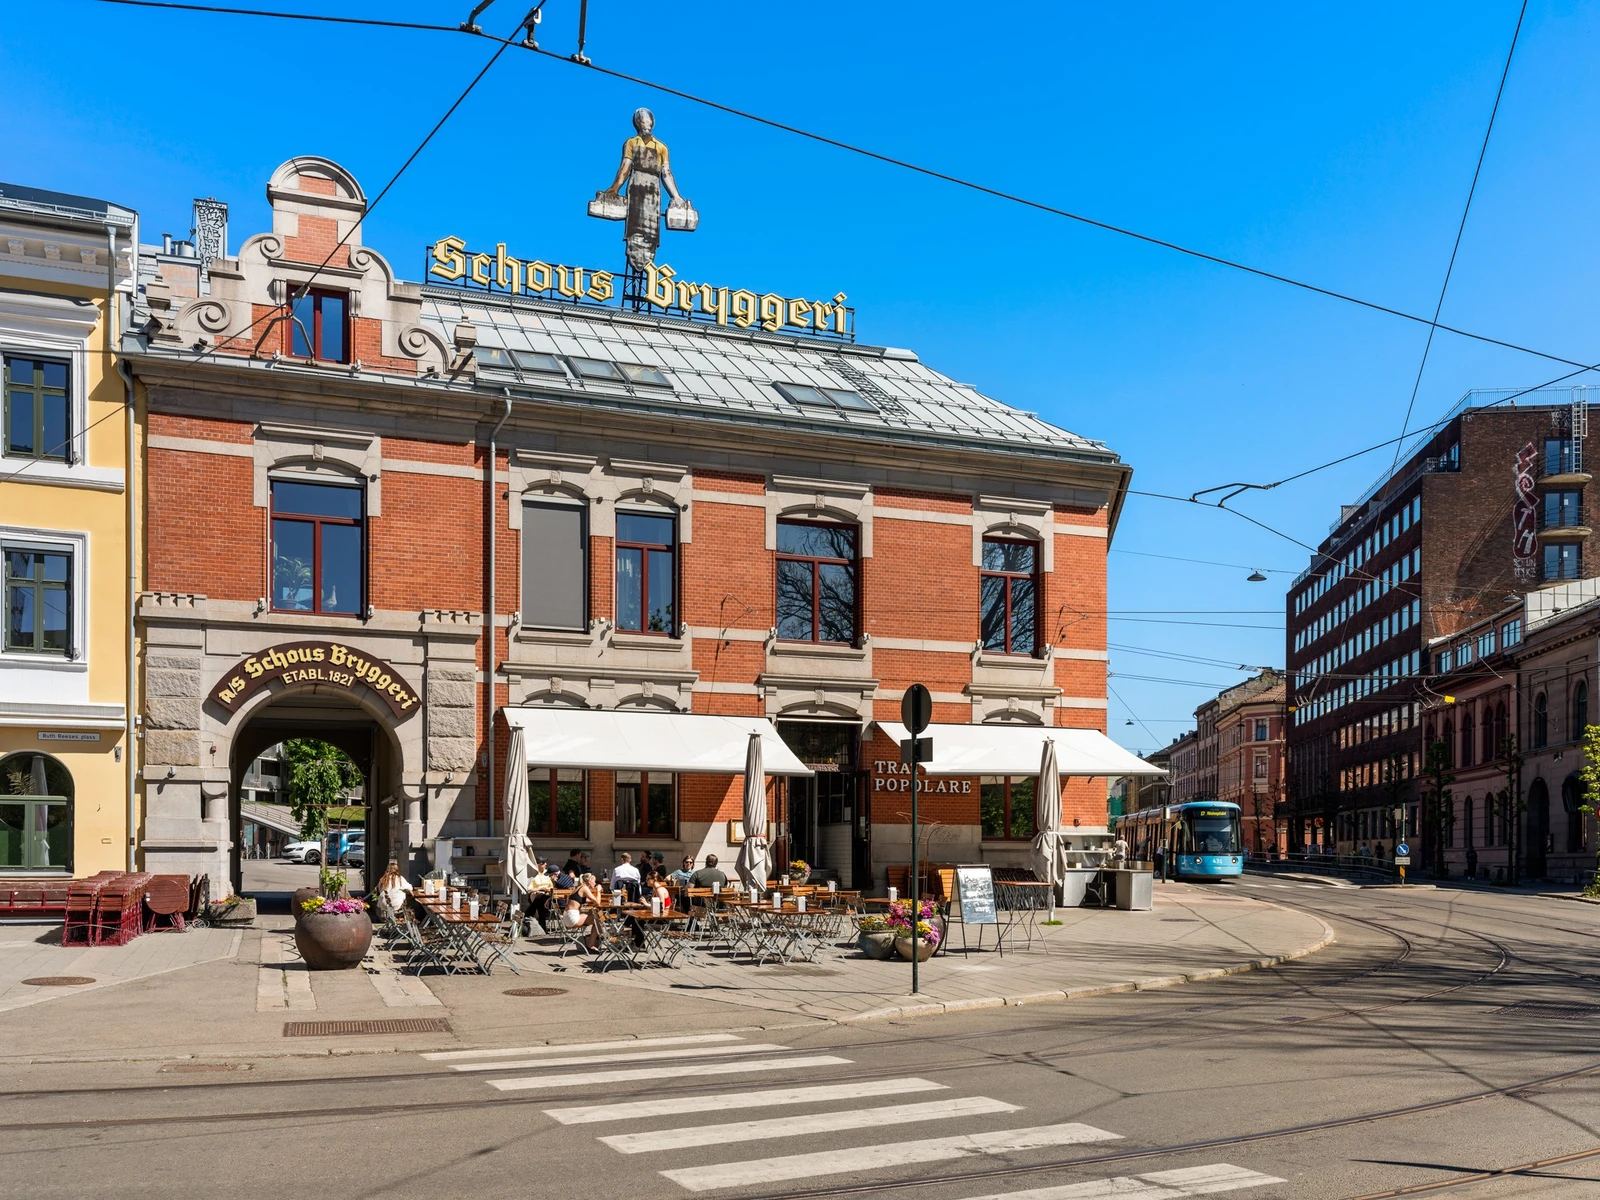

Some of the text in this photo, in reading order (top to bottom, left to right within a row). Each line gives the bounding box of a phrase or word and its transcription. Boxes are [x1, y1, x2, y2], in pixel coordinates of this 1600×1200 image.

[430, 235, 848, 333] Schous Bryggeri
[218, 644, 418, 710] A/S Schous Bryggeri
